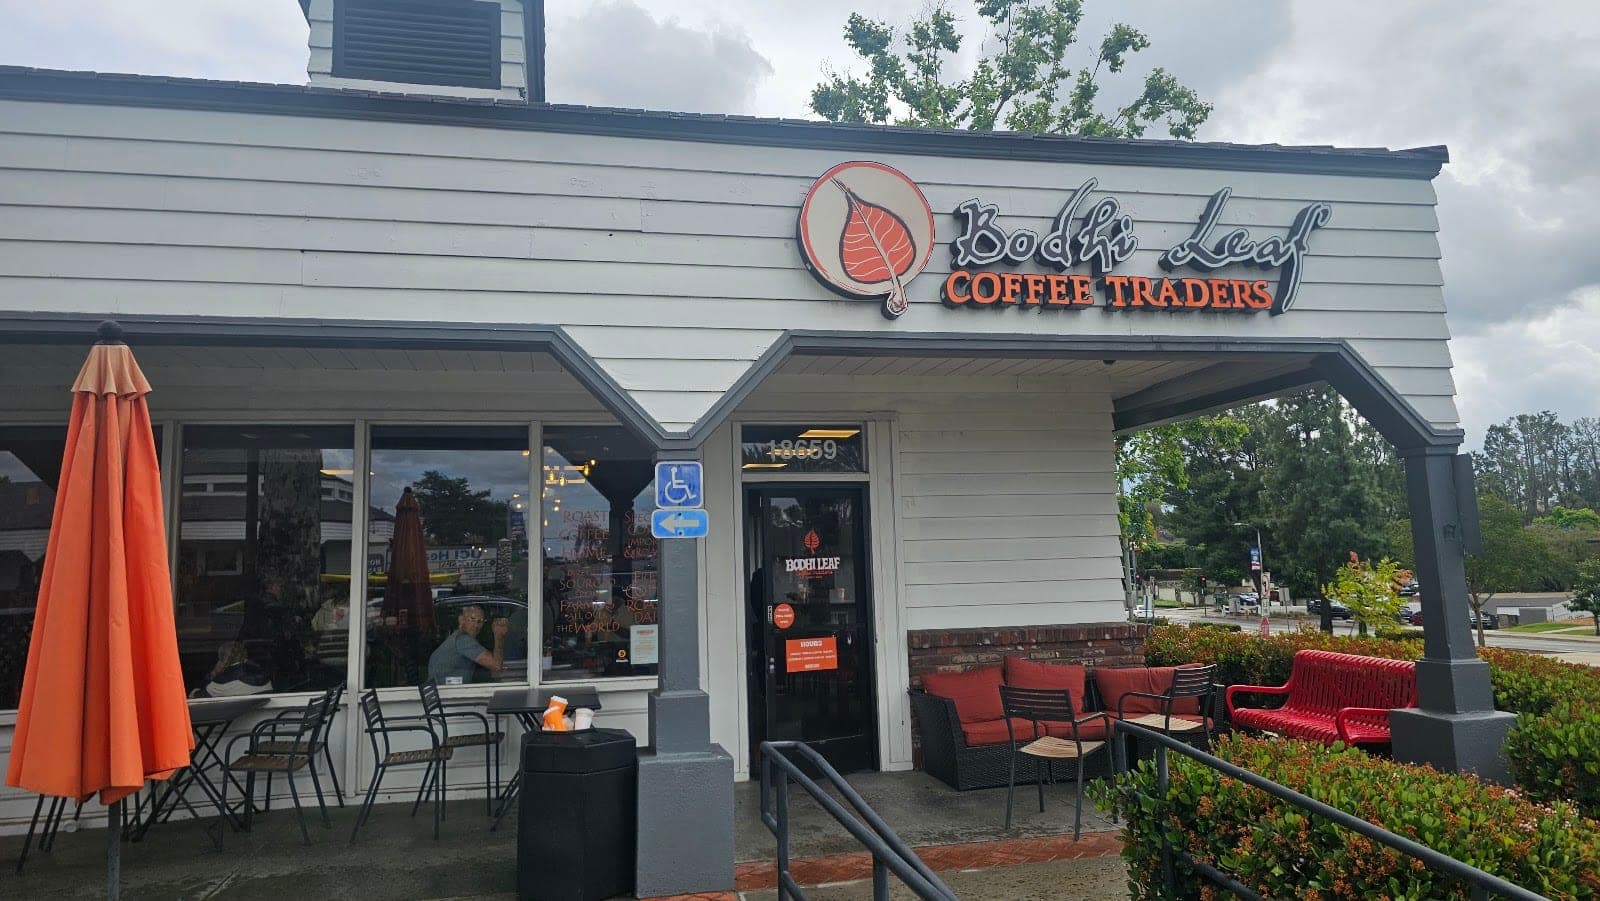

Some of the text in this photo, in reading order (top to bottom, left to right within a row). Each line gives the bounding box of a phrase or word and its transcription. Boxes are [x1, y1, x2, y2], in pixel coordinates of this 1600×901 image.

[954, 176, 1332, 313] Bodhi Leaf
[946, 271, 1273, 309] COFFEE TRADERS
[769, 439, 837, 461] 18659
[785, 557, 840, 571] BODHI LEAF
[574, 621, 620, 634] WORLD
